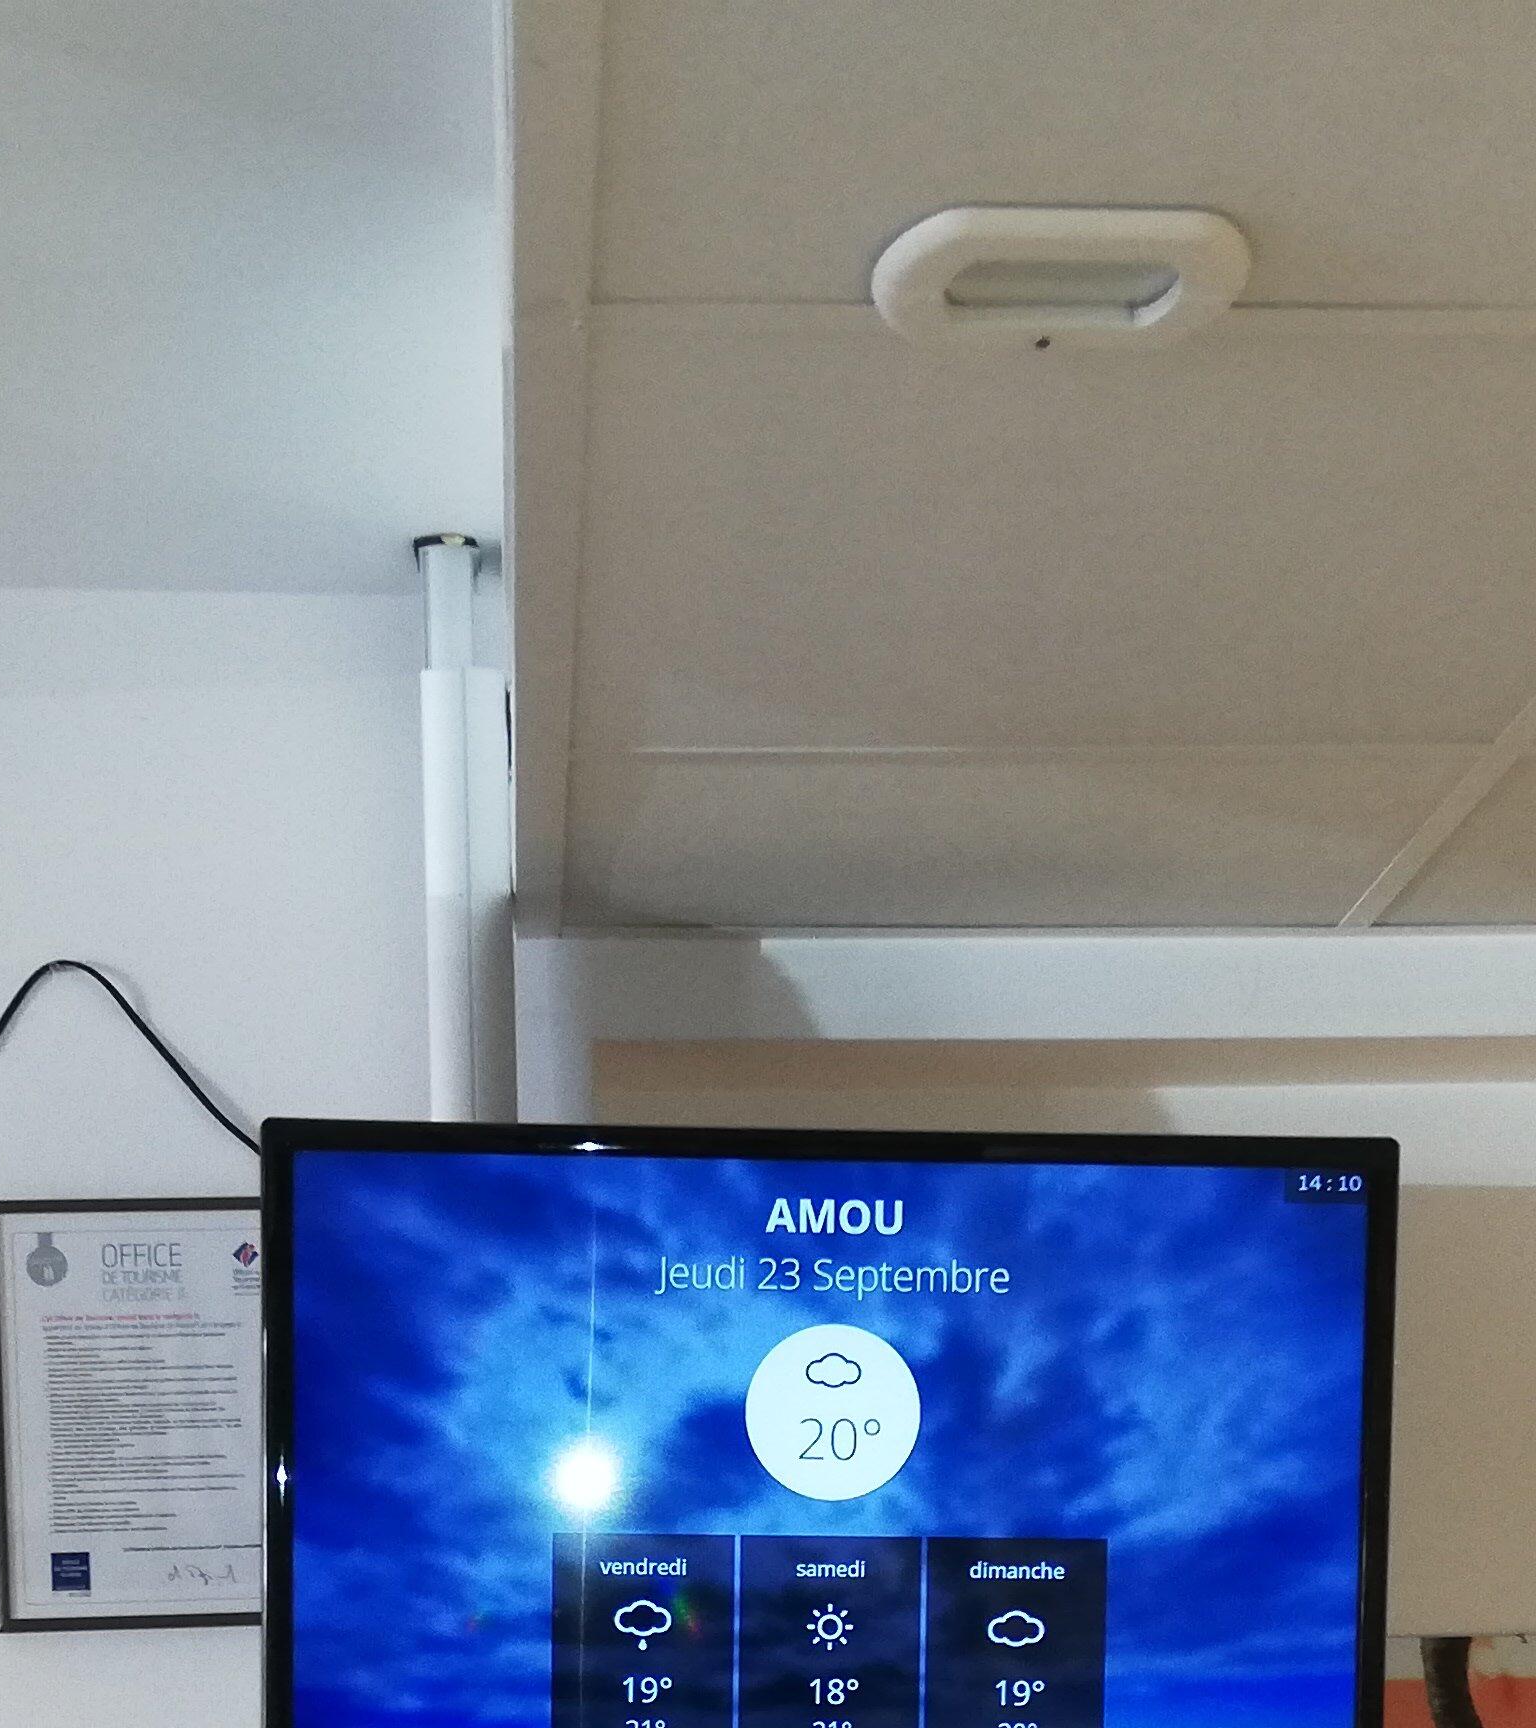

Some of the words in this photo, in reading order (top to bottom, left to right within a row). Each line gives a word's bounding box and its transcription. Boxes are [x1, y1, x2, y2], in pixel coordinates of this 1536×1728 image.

[765, 1198, 904, 1235] AMOU
[102, 1242, 183, 1268] OFFICE
[654, 1255, 746, 1295] Jeudi
[757, 1257, 801, 1291] 23
[813, 1258, 1011, 1301] Septembre
[798, 1417, 881, 1461] 20°
[599, 1557, 688, 1577] vendredi
[795, 1559, 866, 1579] samedi
[968, 1561, 1066, 1581] dimanche
[621, 1676, 673, 1704] 19°
[808, 1678, 860, 1705] 18°
[993, 1679, 1046, 1707] 19°
